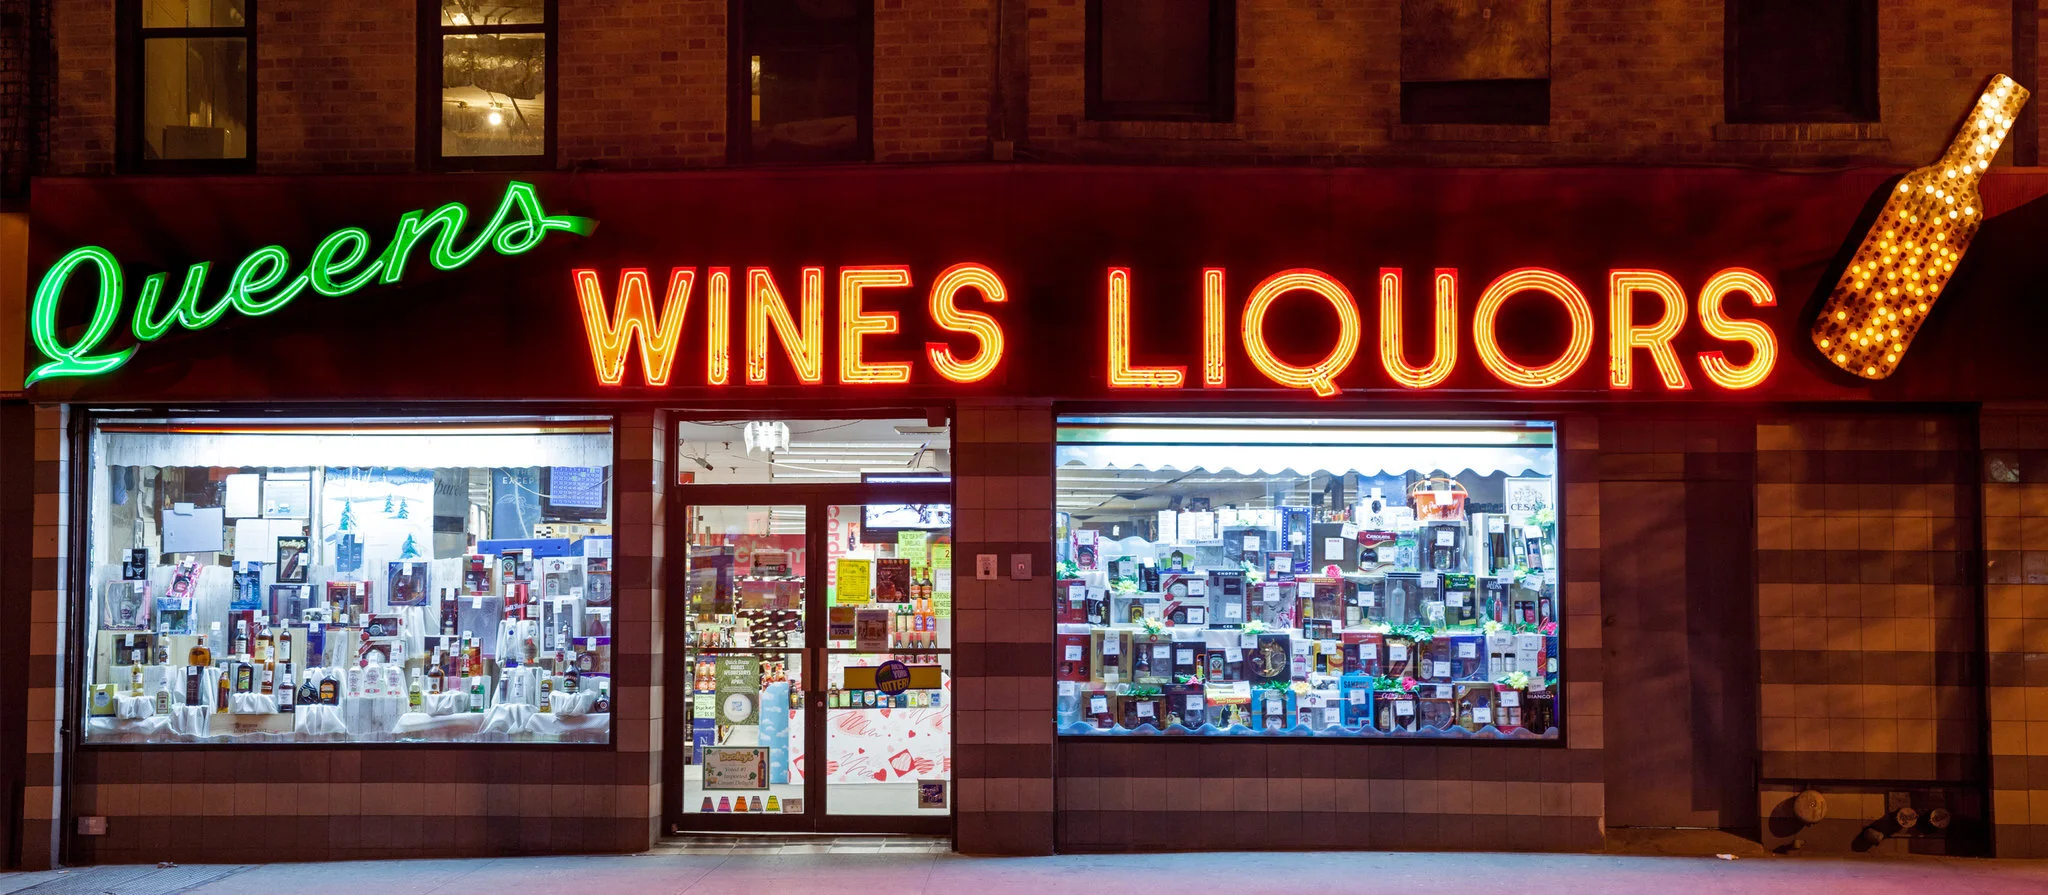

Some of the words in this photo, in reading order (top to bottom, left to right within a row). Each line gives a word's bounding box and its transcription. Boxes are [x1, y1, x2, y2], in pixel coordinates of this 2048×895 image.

[25, 180, 599, 388] Queens
[573, 263, 1009, 387] WINES
[1107, 264, 1779, 398] LIQUORS
[878, 678, 910, 692] LOTTERY
[720, 751, 754, 764] Dooley's
